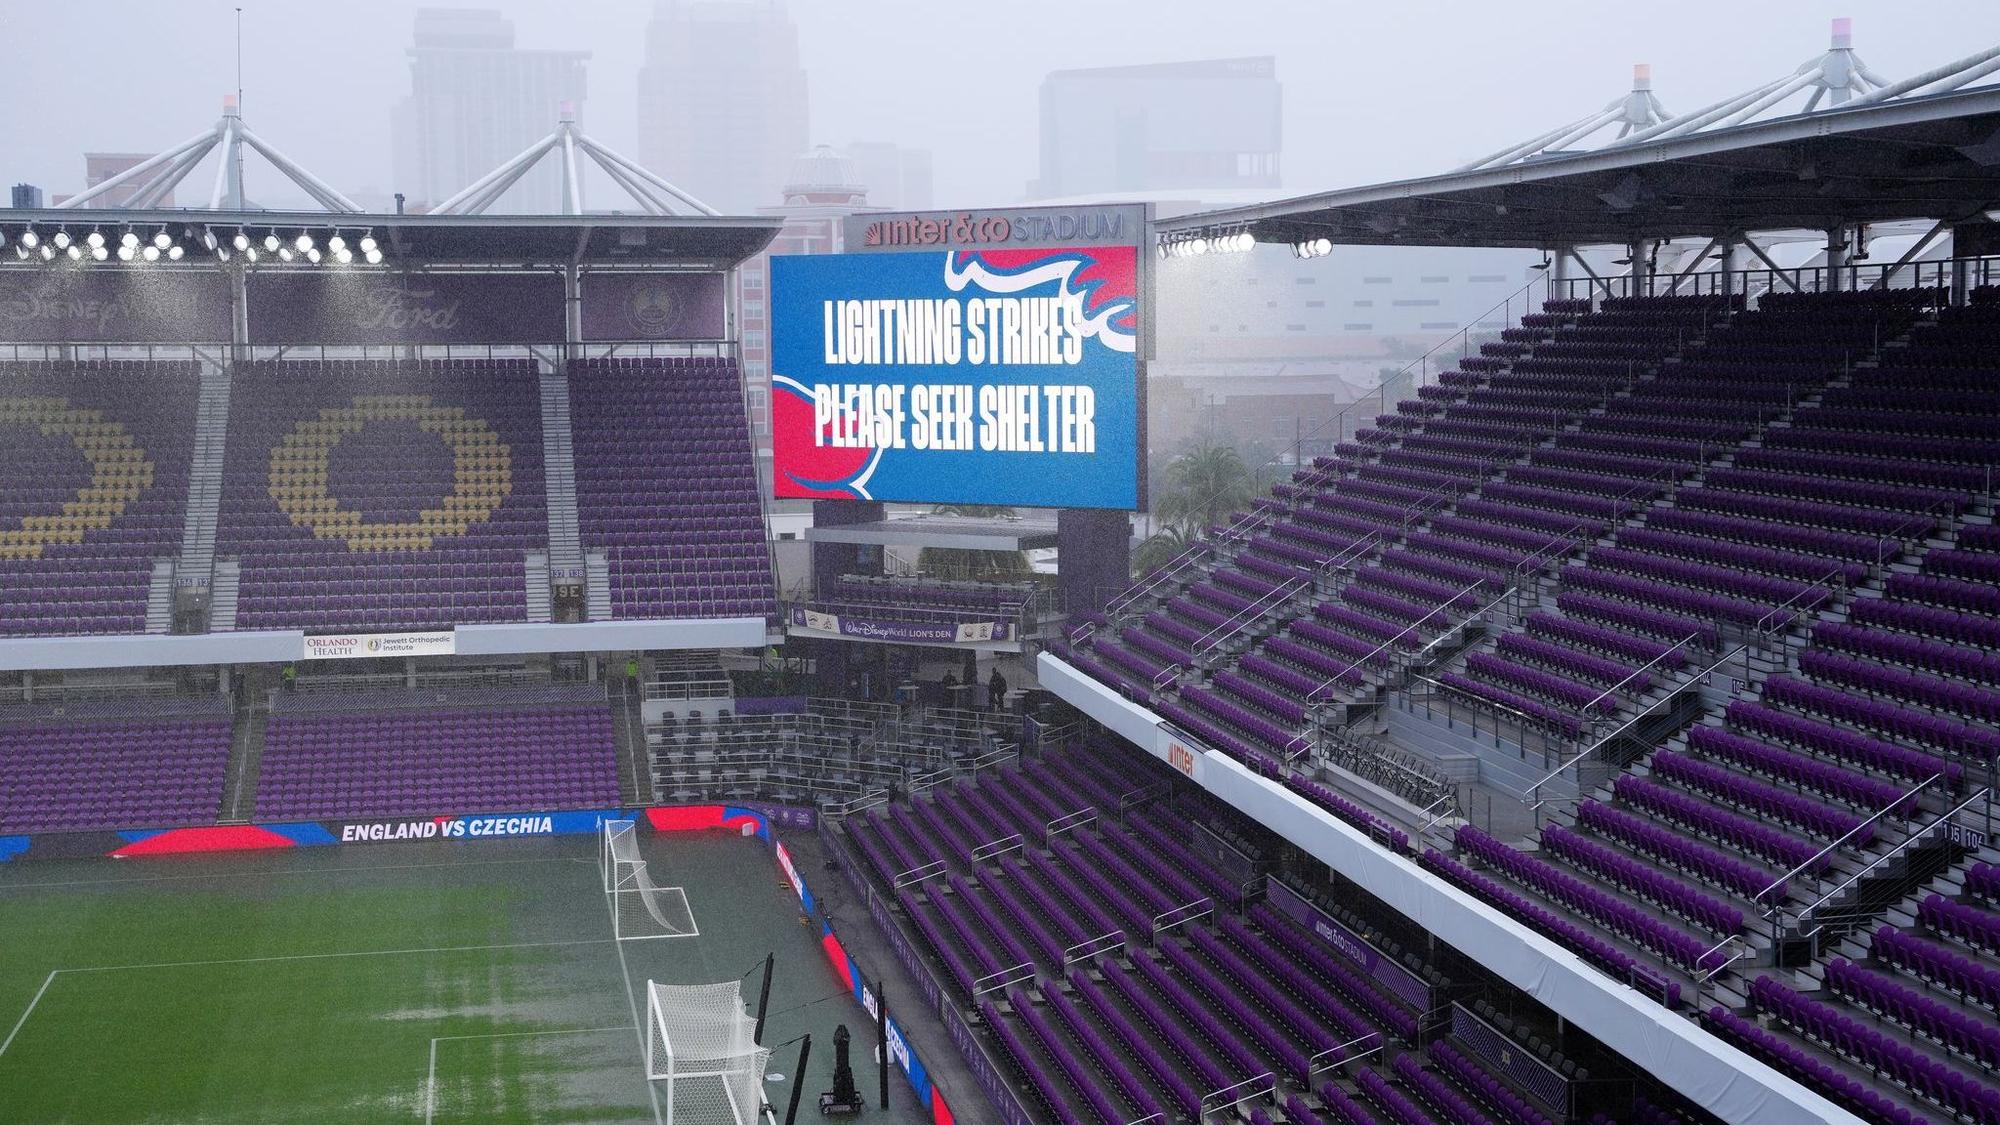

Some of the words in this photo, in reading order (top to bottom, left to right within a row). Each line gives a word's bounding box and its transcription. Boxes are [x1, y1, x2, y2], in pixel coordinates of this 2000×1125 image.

[1013, 211, 1124, 241] STADIUM
[357, 288, 460, 329] Ford
[824, 298, 962, 365] LIGHTNING
[967, 297, 1083, 365] STRIKES
[814, 383, 906, 449] PLEASE
[911, 384, 974, 451] SEEK
[979, 384, 1095, 453] SHELTER
[307, 638, 358, 647] ORLANDO
[409, 636, 450, 645] Orthopedic
[909, 630, 934, 638] LION'S
[313, 647, 352, 656] HEALTH
[342, 823, 437, 842] ENGLAND
[441, 821, 465, 837] VS
[469, 817, 553, 836] CZECHIA
